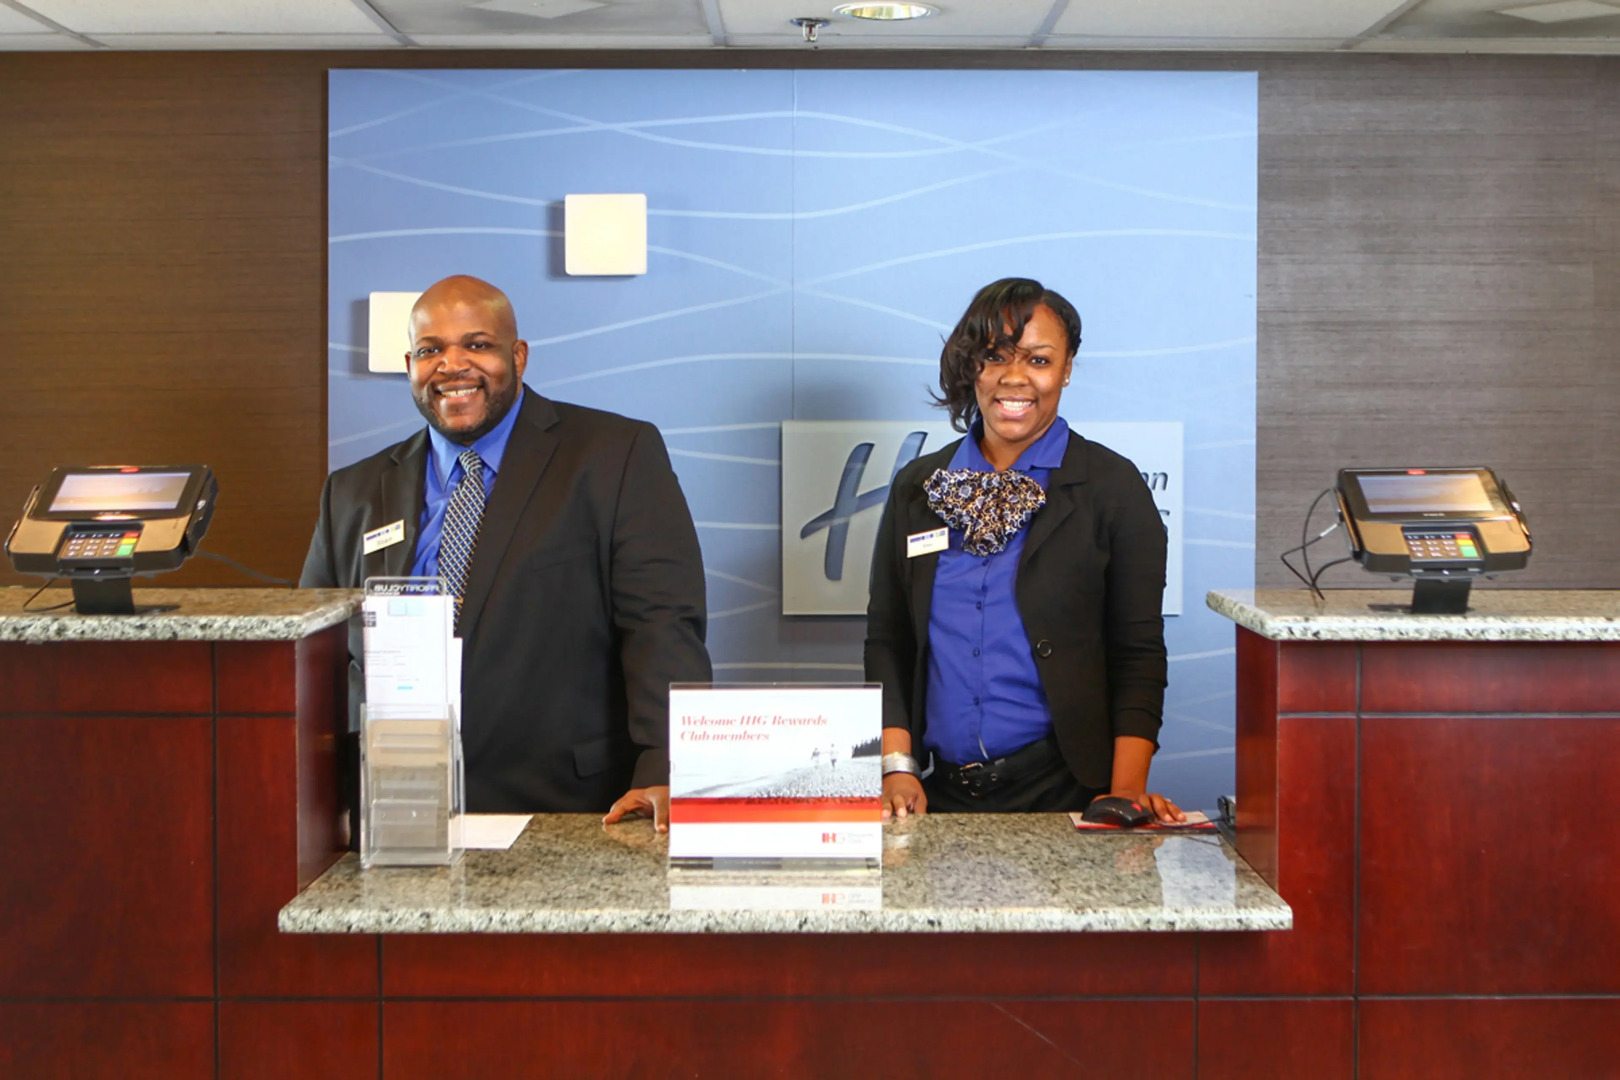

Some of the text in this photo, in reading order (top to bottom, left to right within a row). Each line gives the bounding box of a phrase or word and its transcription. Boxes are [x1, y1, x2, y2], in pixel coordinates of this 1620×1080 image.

[681, 715, 828, 726] Welcome IHG Rewards
[680, 730, 770, 742] Club members
